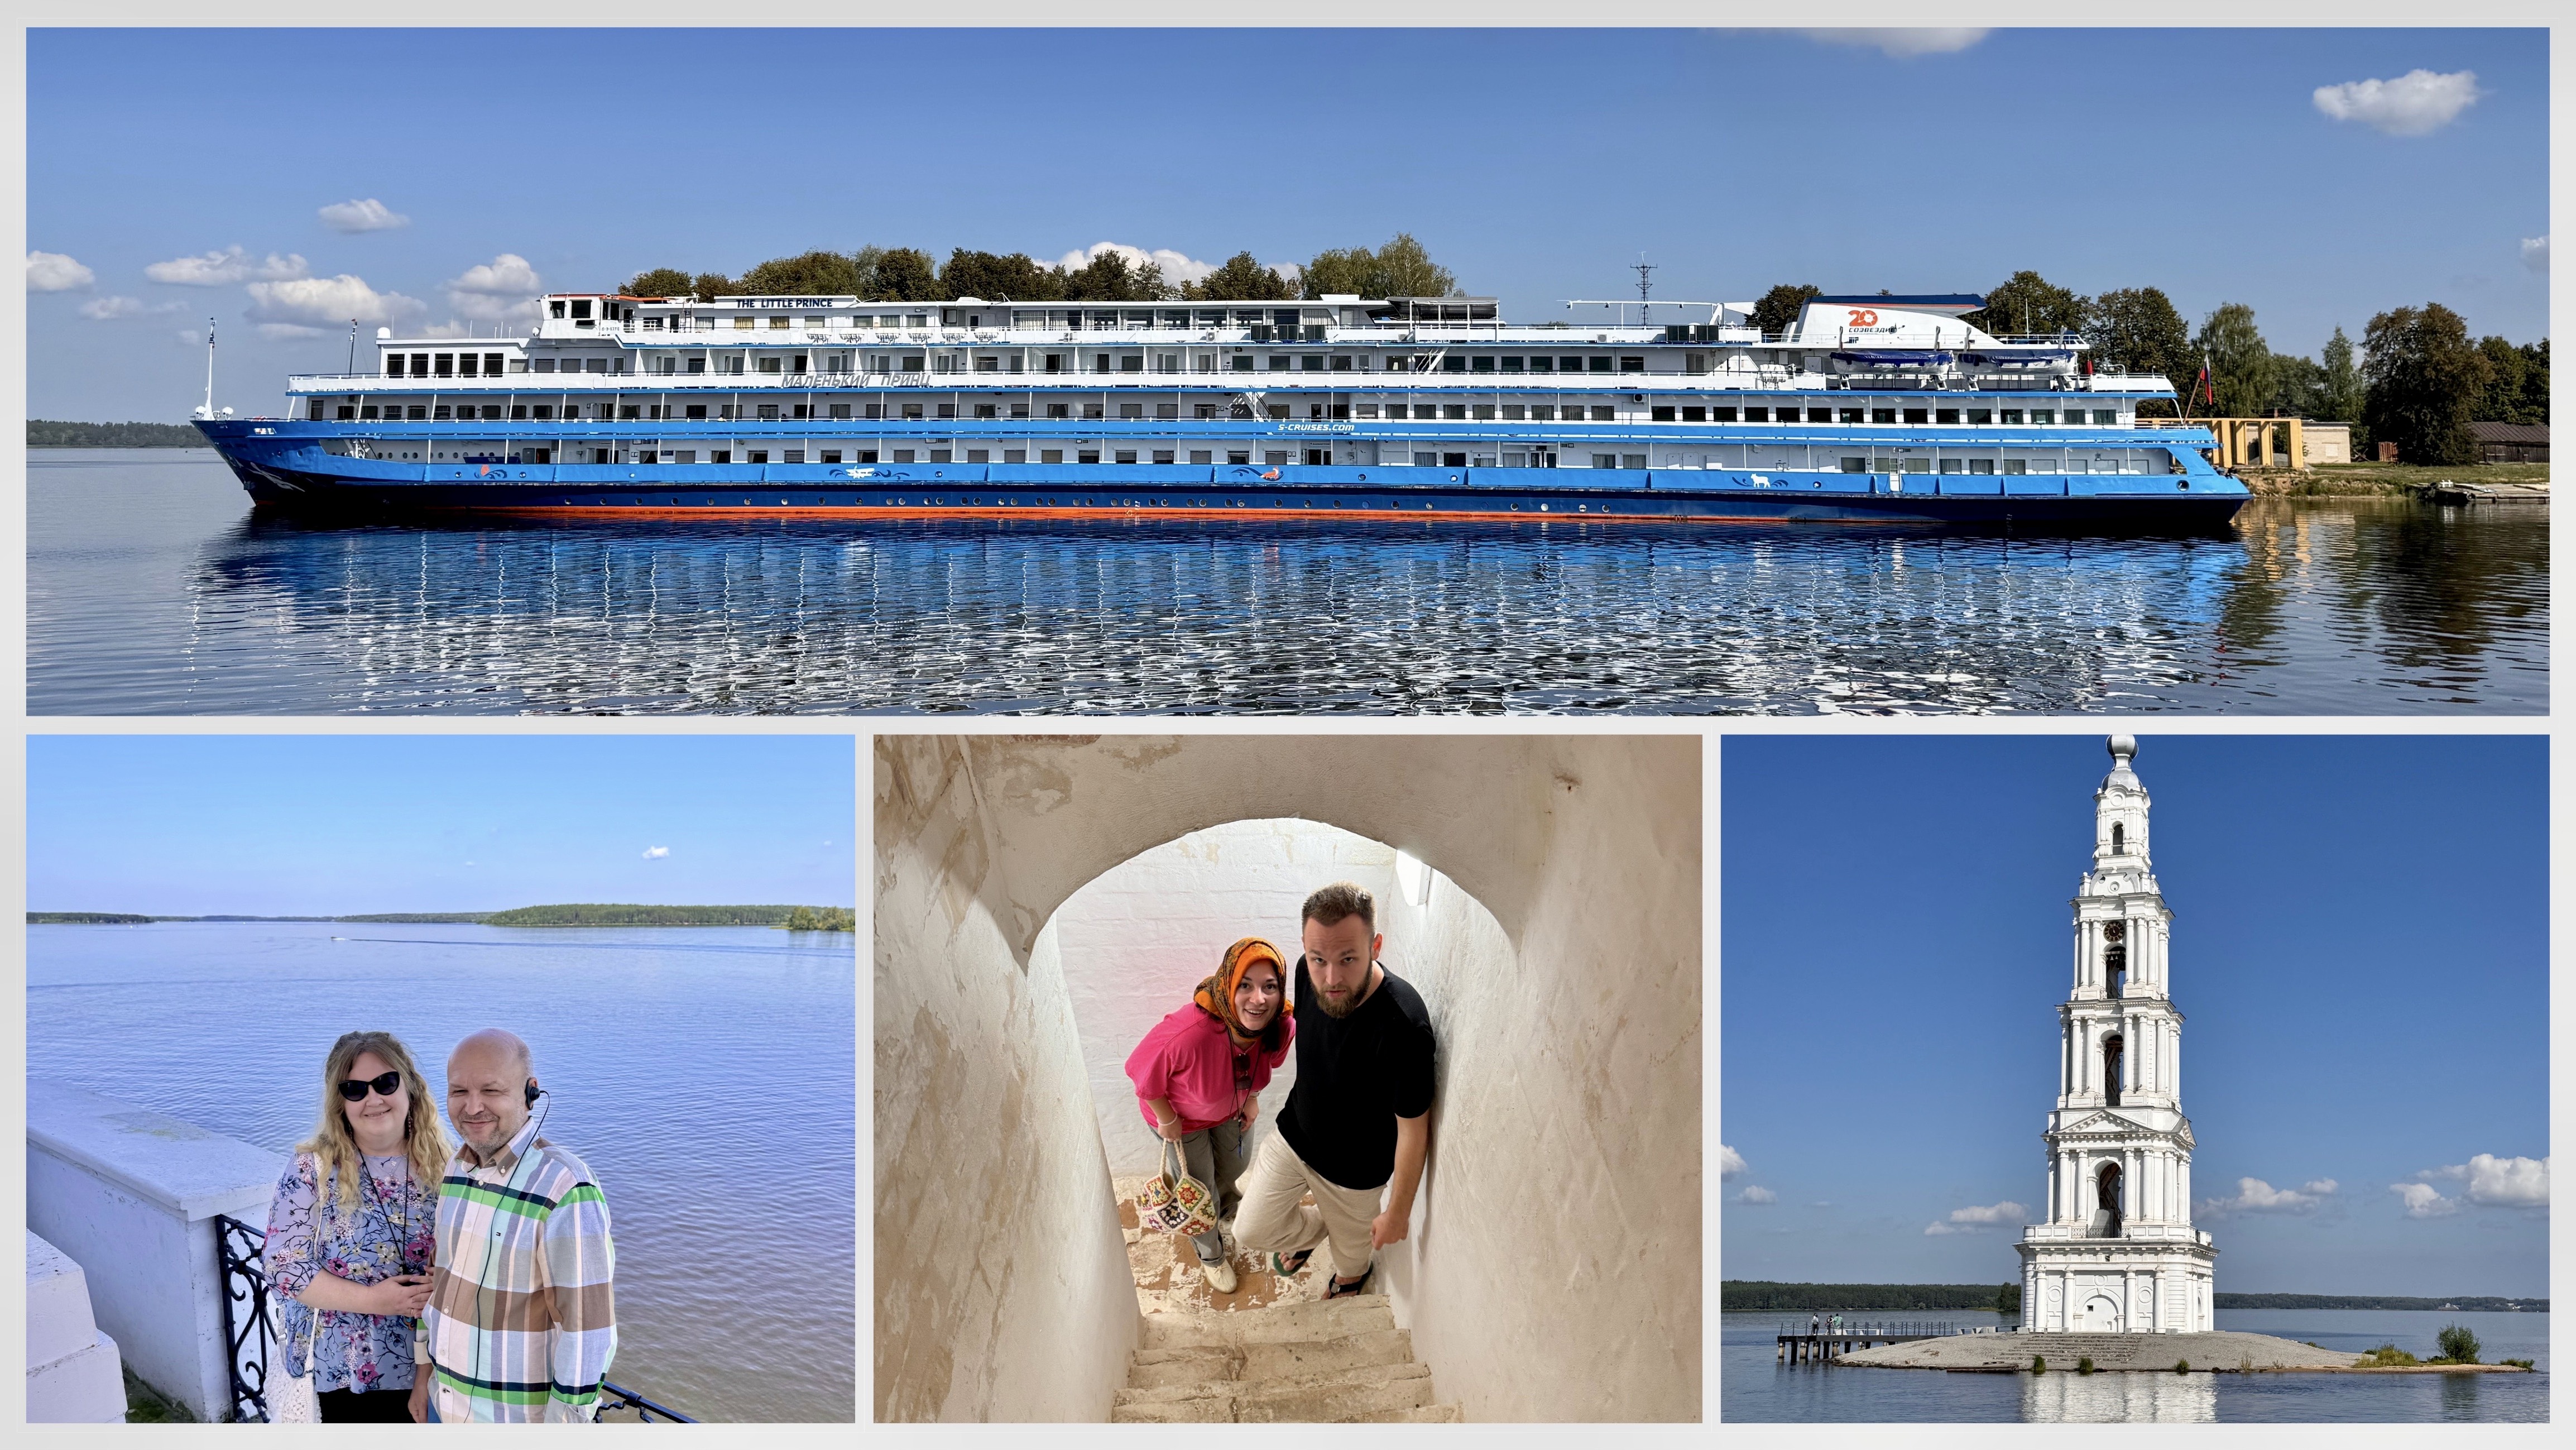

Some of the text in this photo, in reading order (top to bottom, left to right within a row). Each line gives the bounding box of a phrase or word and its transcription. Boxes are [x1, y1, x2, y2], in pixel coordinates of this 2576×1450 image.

[736, 299, 833, 308] THE LITTLE PRINCE
[1848, 310, 1878, 327] 20
[781, 372, 930, 387] МАЛЕНЬКИЙ ПРИНЦ
